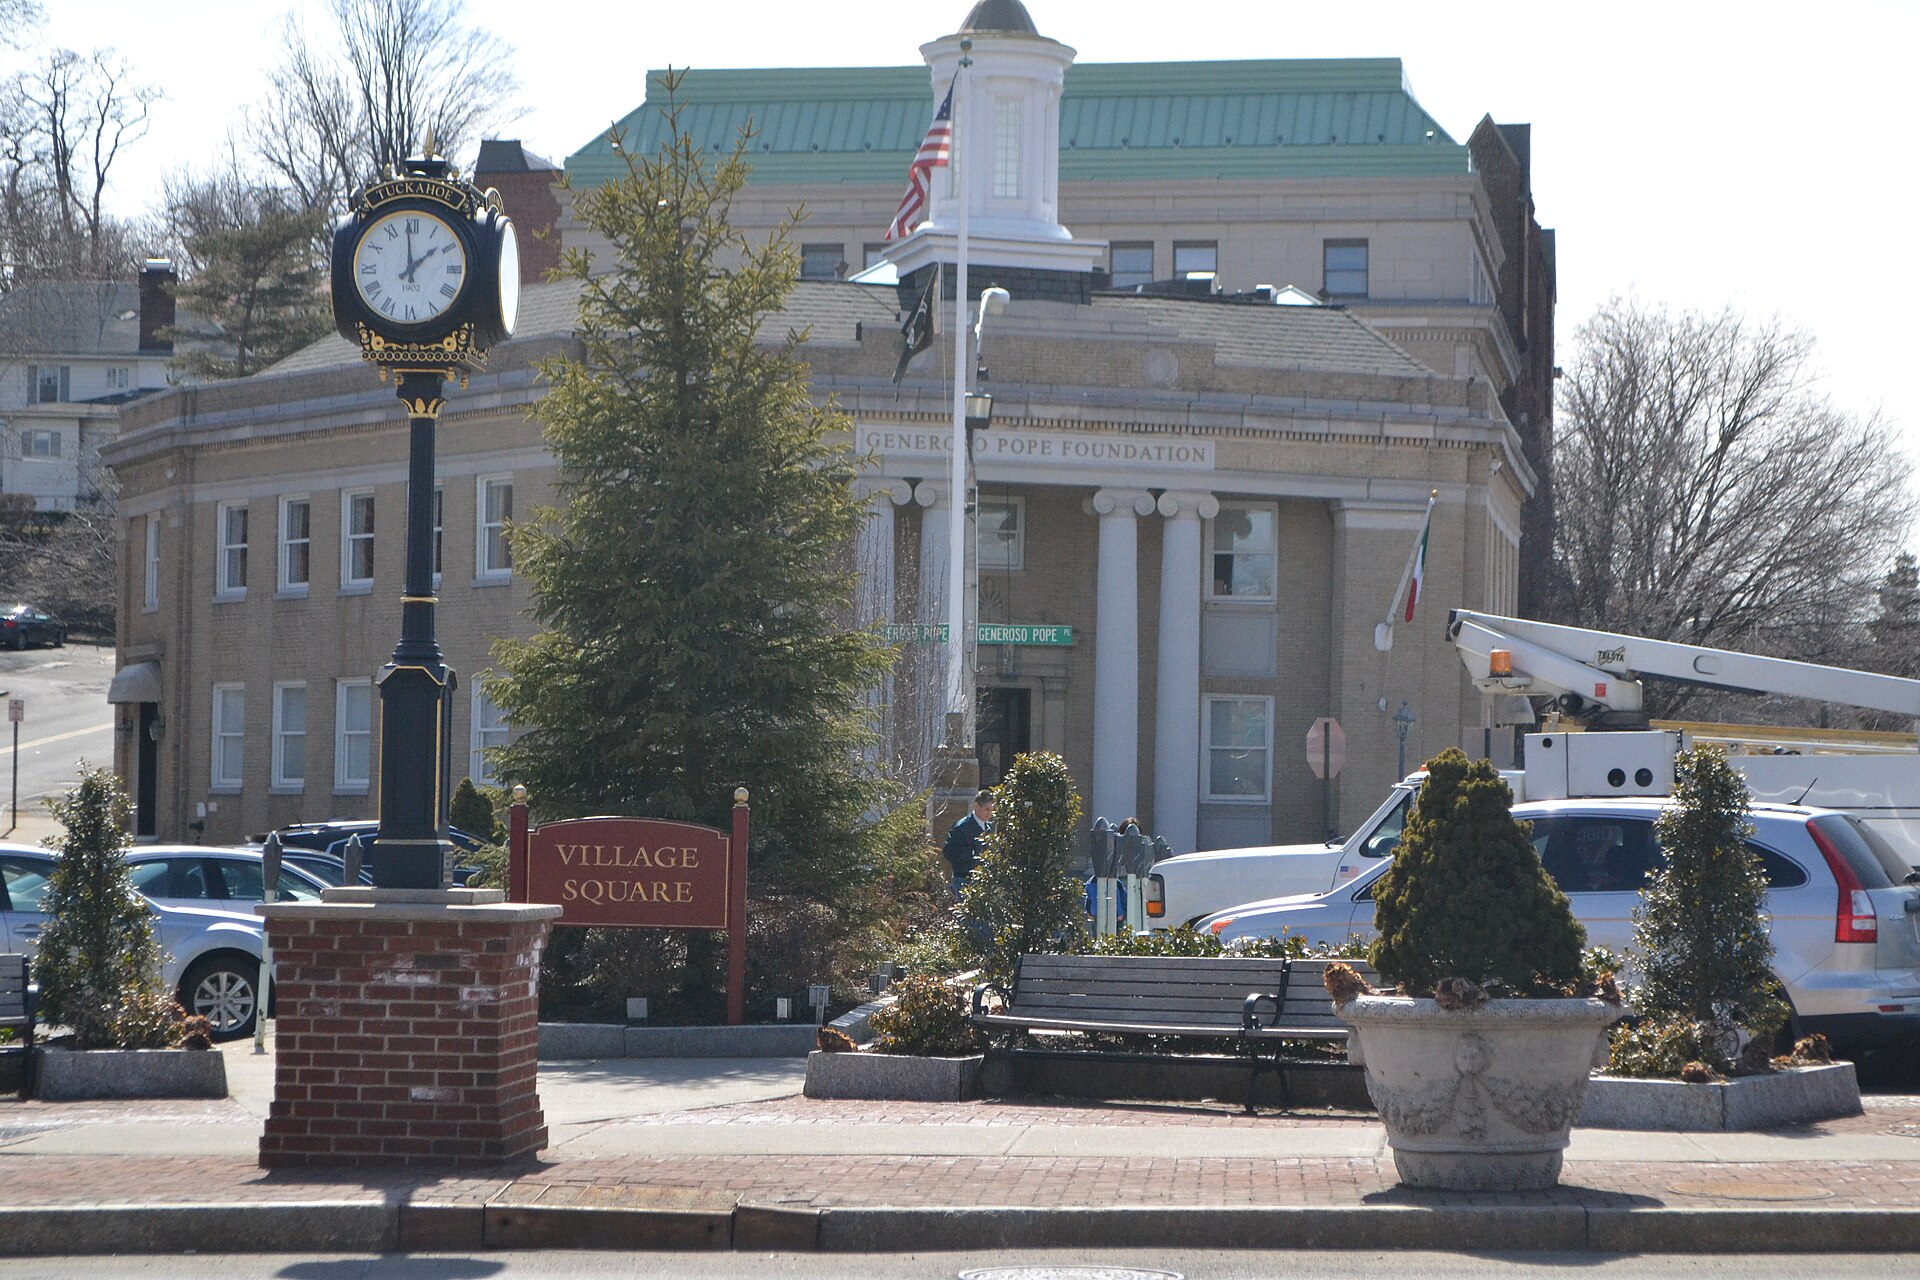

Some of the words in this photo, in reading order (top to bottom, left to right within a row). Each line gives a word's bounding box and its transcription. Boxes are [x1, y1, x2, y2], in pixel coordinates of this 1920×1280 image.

[375, 182, 454, 200] TUCKAHOE
[402, 284, 420, 293] 1902
[998, 437, 1052, 456] POPE
[1061, 441, 1206, 463] FOUNDATION
[978, 627, 1028, 642] GENEROSO
[1032, 628, 1058, 642] POPE
[1598, 650, 1625, 663] TELSTA
[554, 844, 700, 868] VILLAGE
[562, 879, 694, 905] SQUARE
